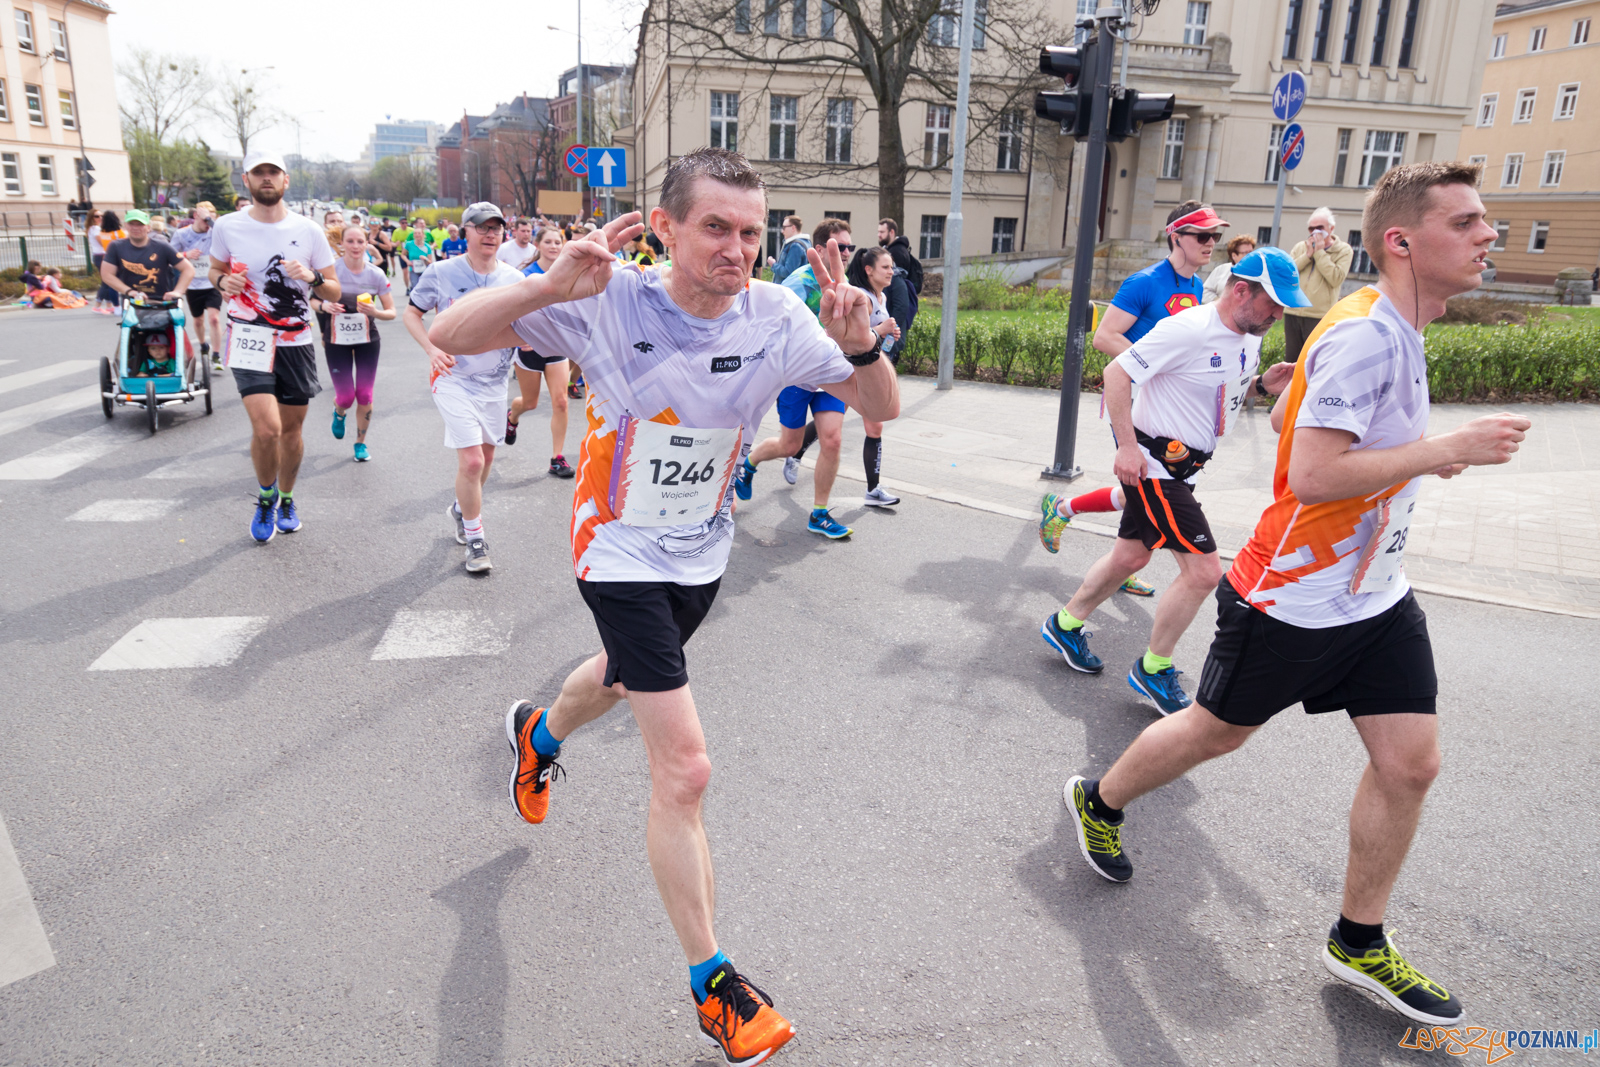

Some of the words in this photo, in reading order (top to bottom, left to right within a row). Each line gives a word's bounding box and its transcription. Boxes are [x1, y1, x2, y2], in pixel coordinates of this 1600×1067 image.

[340, 322, 363, 331] 3623
[236, 338, 266, 352] 7822
[633, 341, 655, 354] 4F
[650, 457, 715, 486] 1246
[661, 490, 699, 500] Wojciech
[1385, 526, 1408, 554] 28
